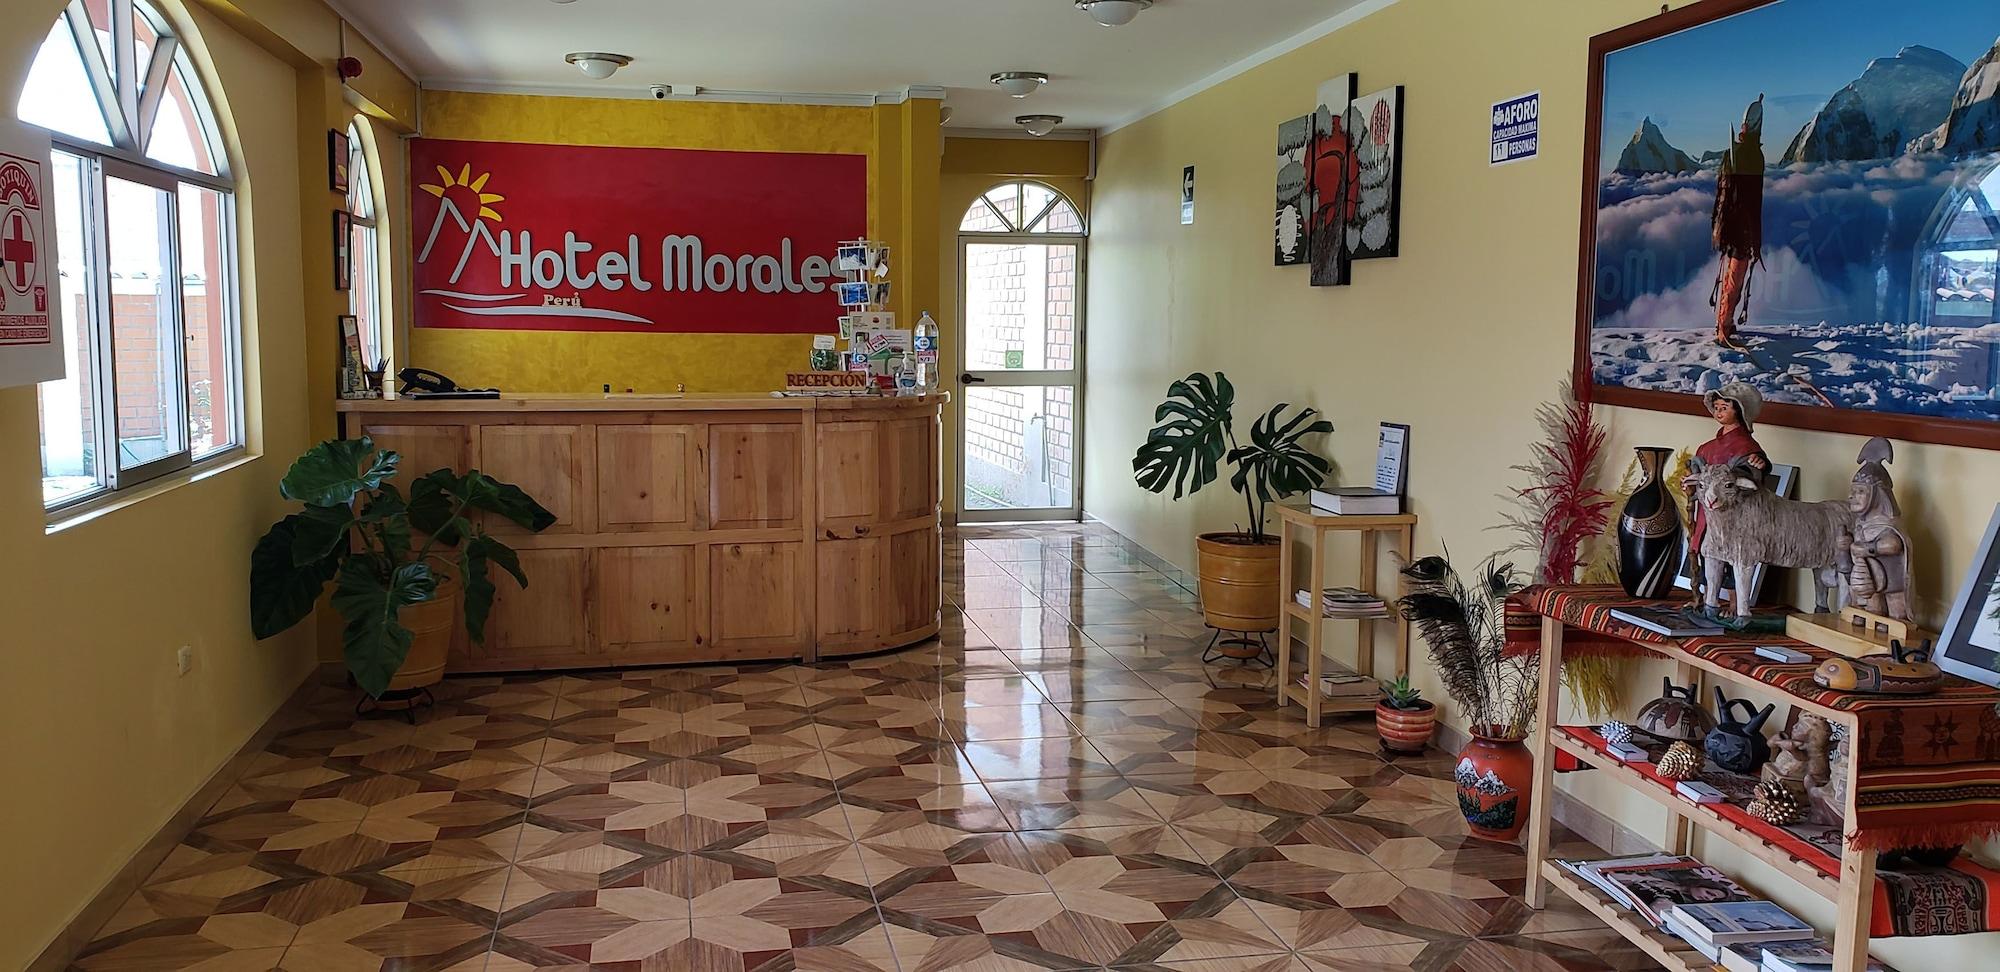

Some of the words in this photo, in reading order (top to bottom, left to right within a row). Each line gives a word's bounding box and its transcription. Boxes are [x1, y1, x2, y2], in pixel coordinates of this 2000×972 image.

[1504, 99, 1538, 126] AFORO
[1509, 137, 1536, 156] PERSONAS
[499, 229, 651, 291] Hotel
[542, 291, 582, 308] Perú
[786, 370, 866, 387] RECEPCIÓN
